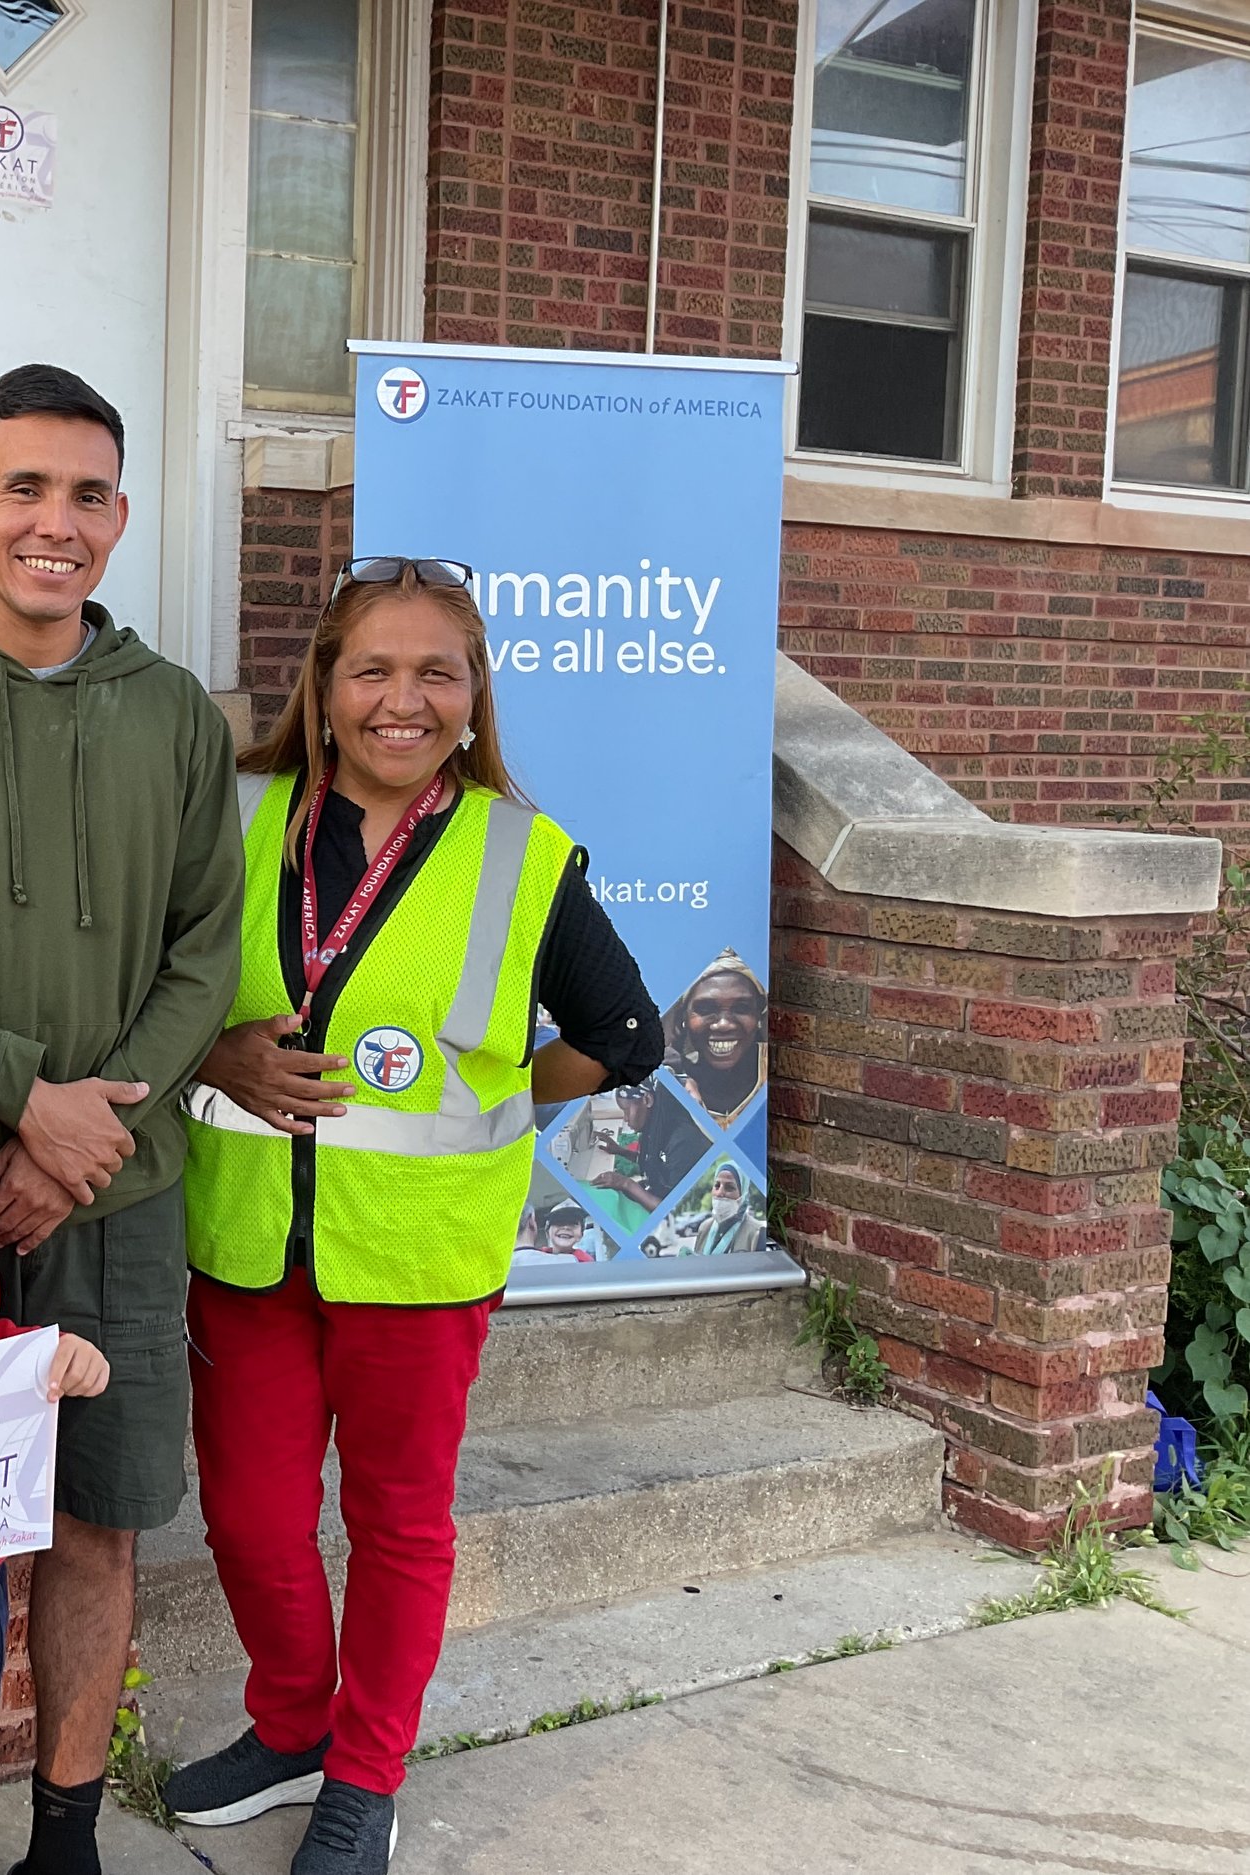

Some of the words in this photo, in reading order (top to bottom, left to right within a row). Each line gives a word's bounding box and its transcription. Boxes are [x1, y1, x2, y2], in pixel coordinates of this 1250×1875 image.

[437, 389, 504, 408] ZAKAT
[508, 391, 643, 414] FOUNDATION
[649, 397, 672, 415] of
[673, 399, 762, 418] AMERICA
[553, 628, 604, 673] all
[616, 630, 727, 674] else.
[334, 901, 363, 939] ZAKAT
[359, 831, 409, 898] FOUNDATION
[407, 817, 418, 831] of
[303, 888, 315, 940] AMERICA
[9, 1531, 38, 1545] Zakat
